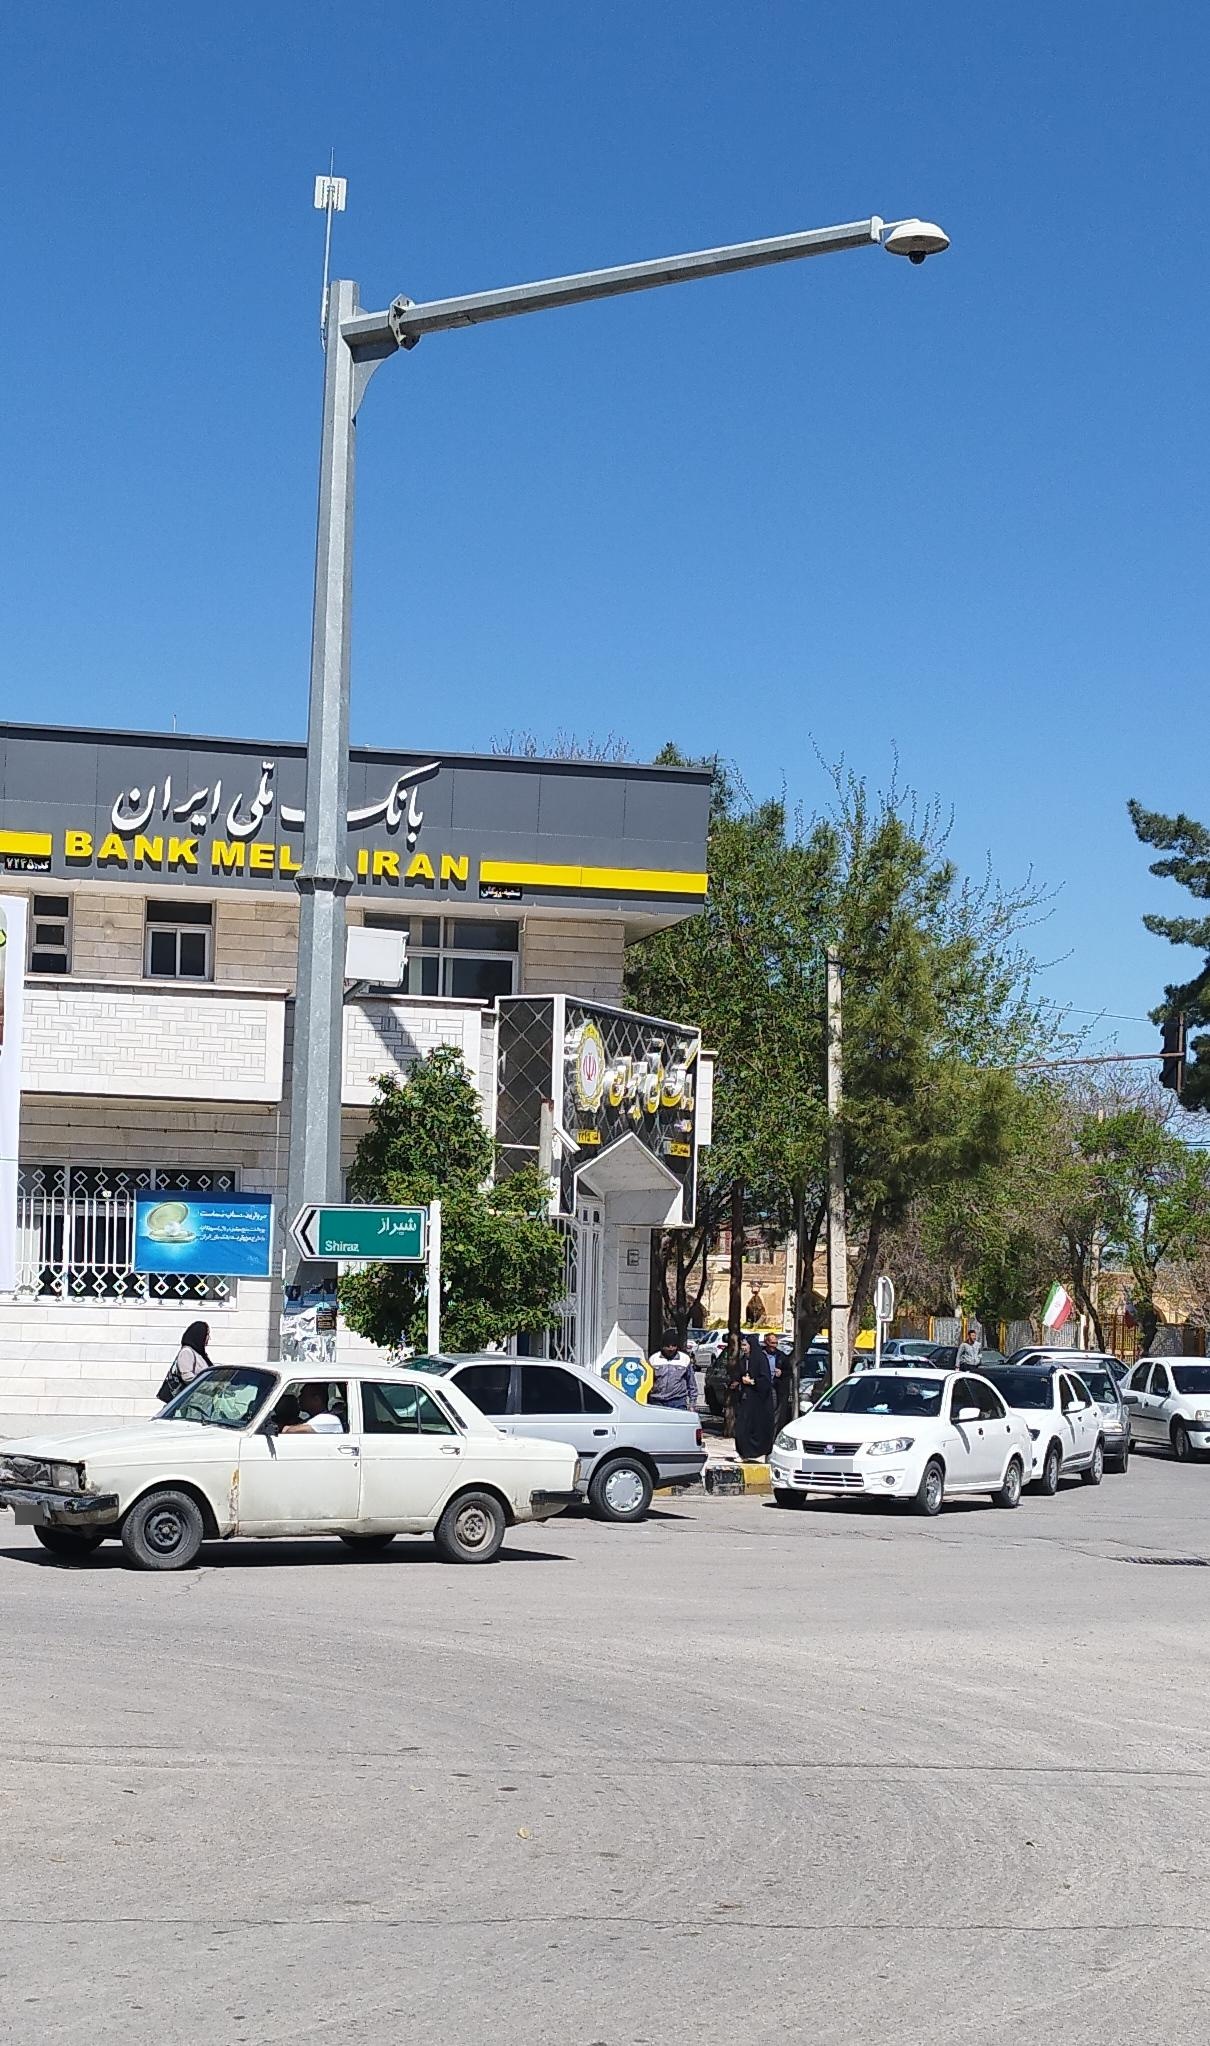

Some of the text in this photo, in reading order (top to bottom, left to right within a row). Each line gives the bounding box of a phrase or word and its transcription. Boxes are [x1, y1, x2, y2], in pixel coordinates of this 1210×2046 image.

[111, 775, 222, 831] ایران
[65, 828, 469, 881] BANK MEL IRAN
[377, 1217, 417, 1236] شیراز
[325, 1240, 359, 1252] Shiraz
